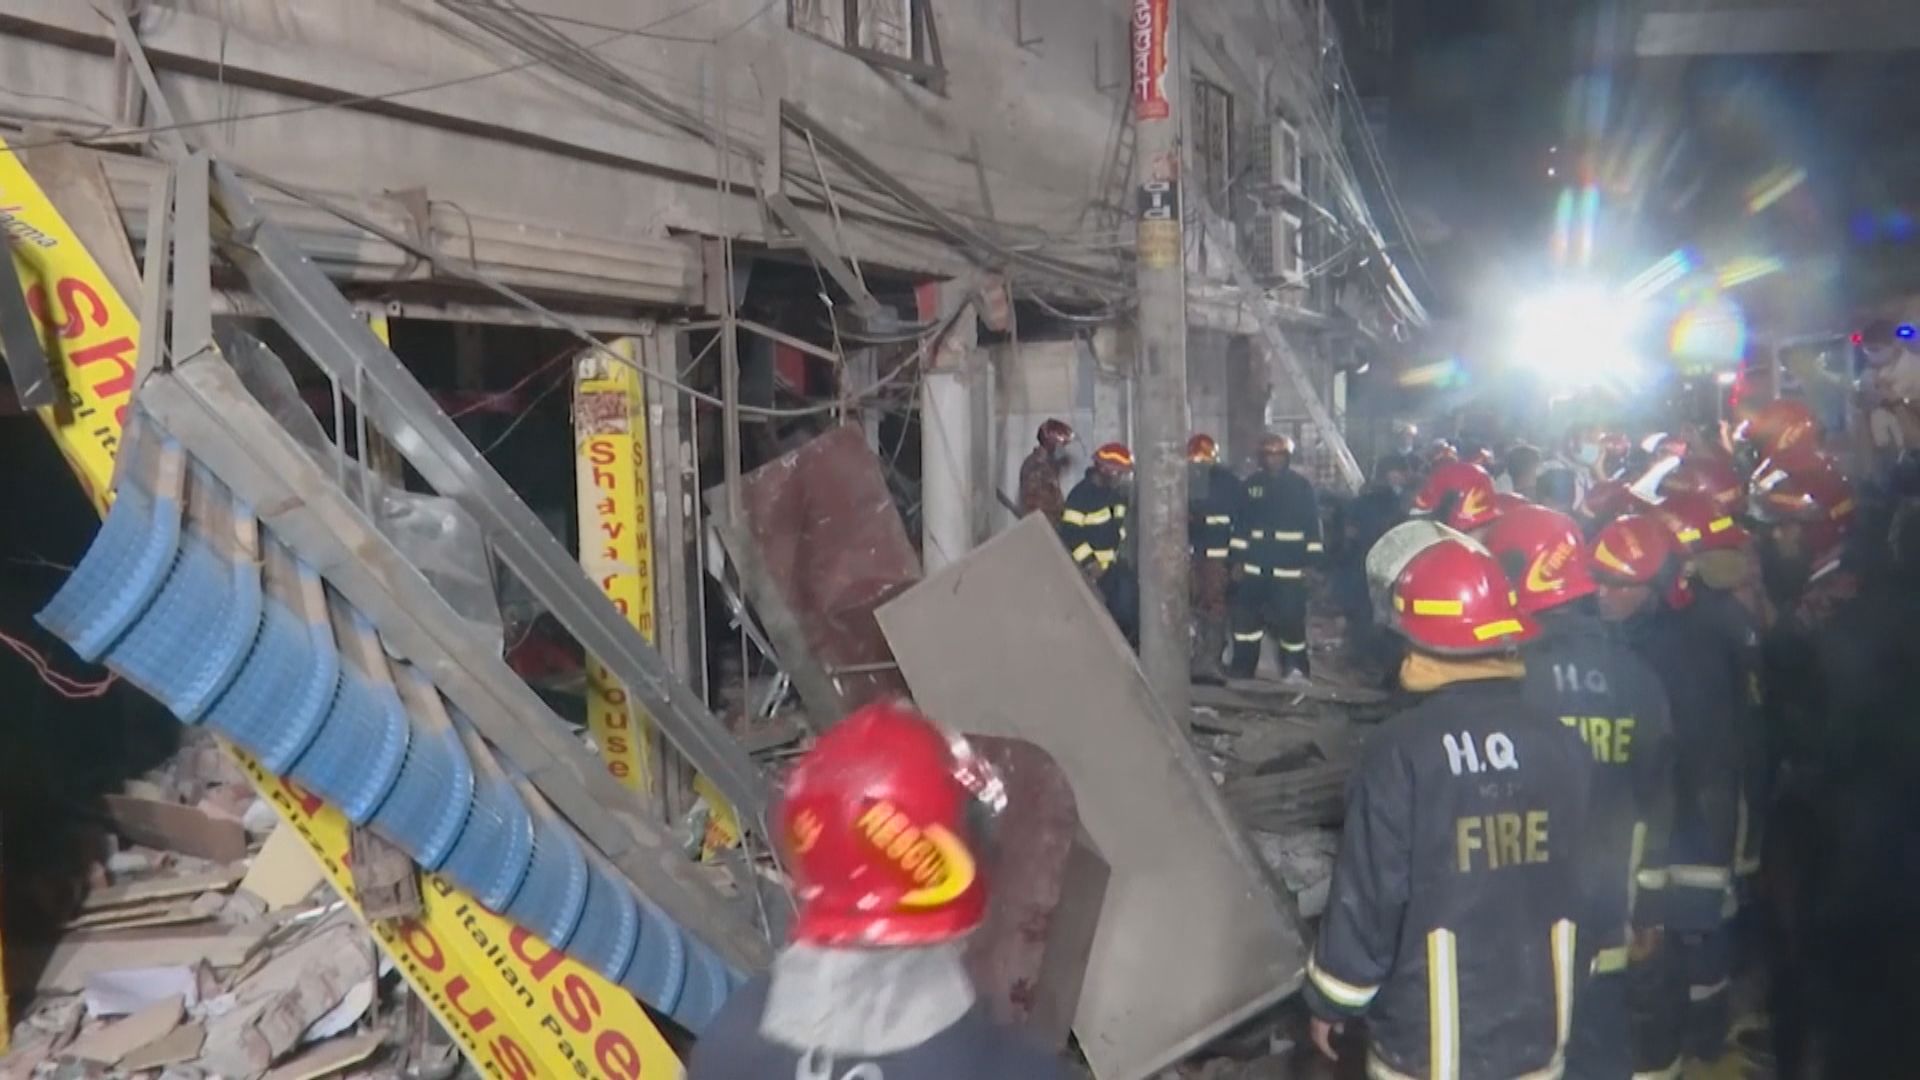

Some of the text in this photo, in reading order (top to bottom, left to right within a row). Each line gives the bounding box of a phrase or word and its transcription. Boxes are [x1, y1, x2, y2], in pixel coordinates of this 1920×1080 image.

[632, 441, 653, 631] Shawarm
[601, 666, 630, 778] ouse
[1442, 730, 1520, 776] H.Q
[1456, 810, 1550, 873] FIRE
[455, 903, 536, 1009] Italian
